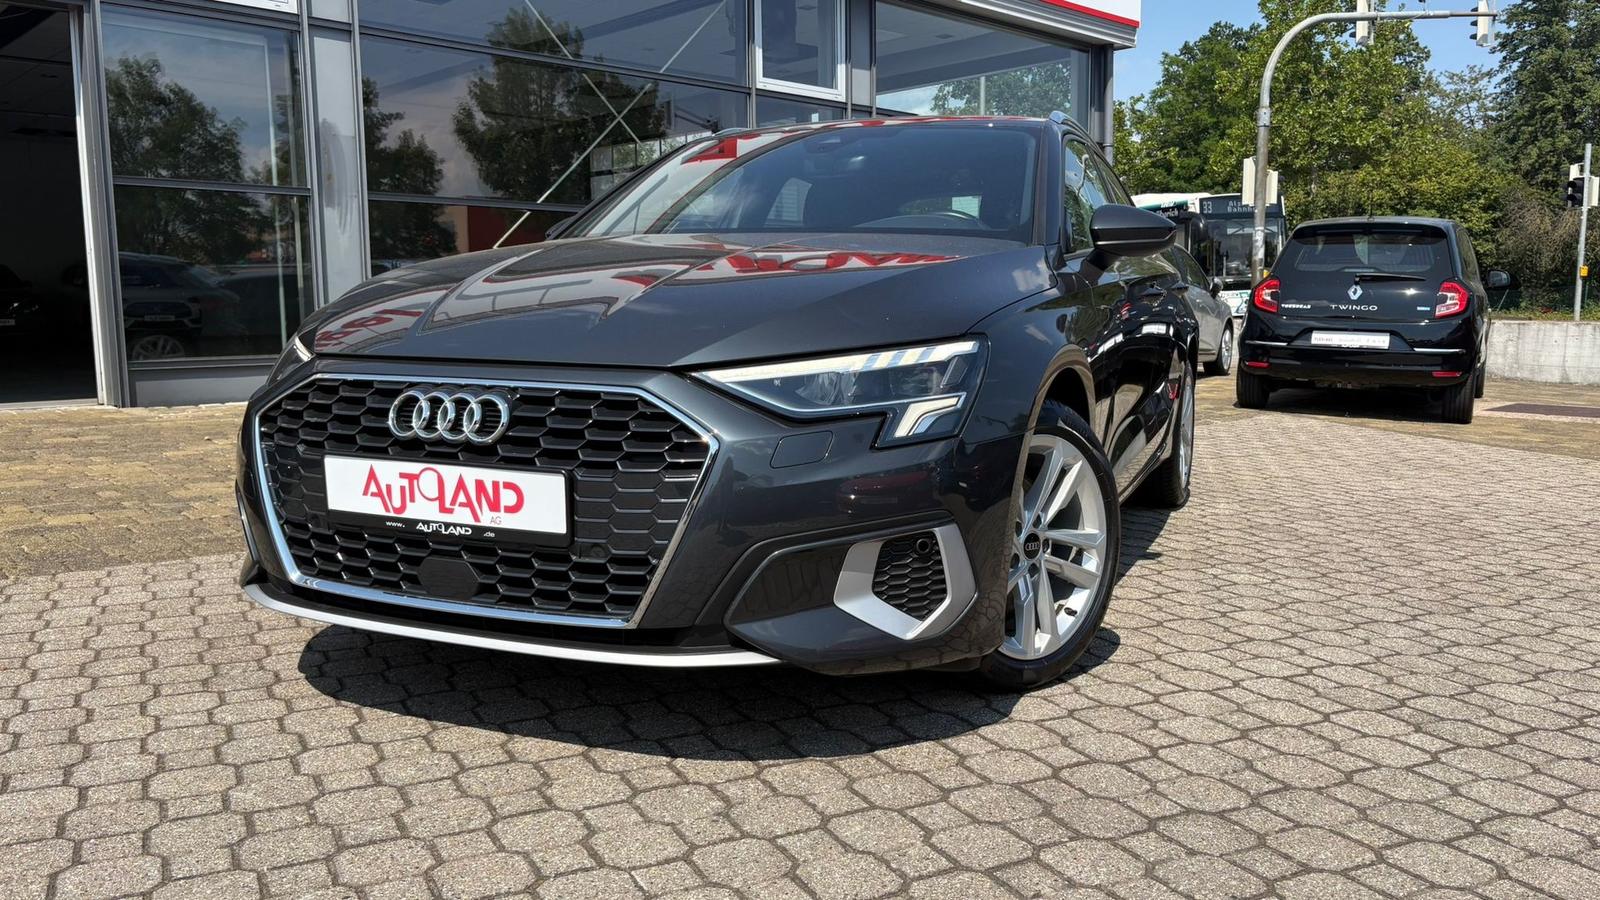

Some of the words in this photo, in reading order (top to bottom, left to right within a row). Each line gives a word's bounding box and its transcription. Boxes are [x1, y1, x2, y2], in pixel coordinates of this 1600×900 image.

[1203, 200, 1213, 214] 33
[362, 464, 525, 523] AUTOLAND
[489, 515, 502, 526] AG
